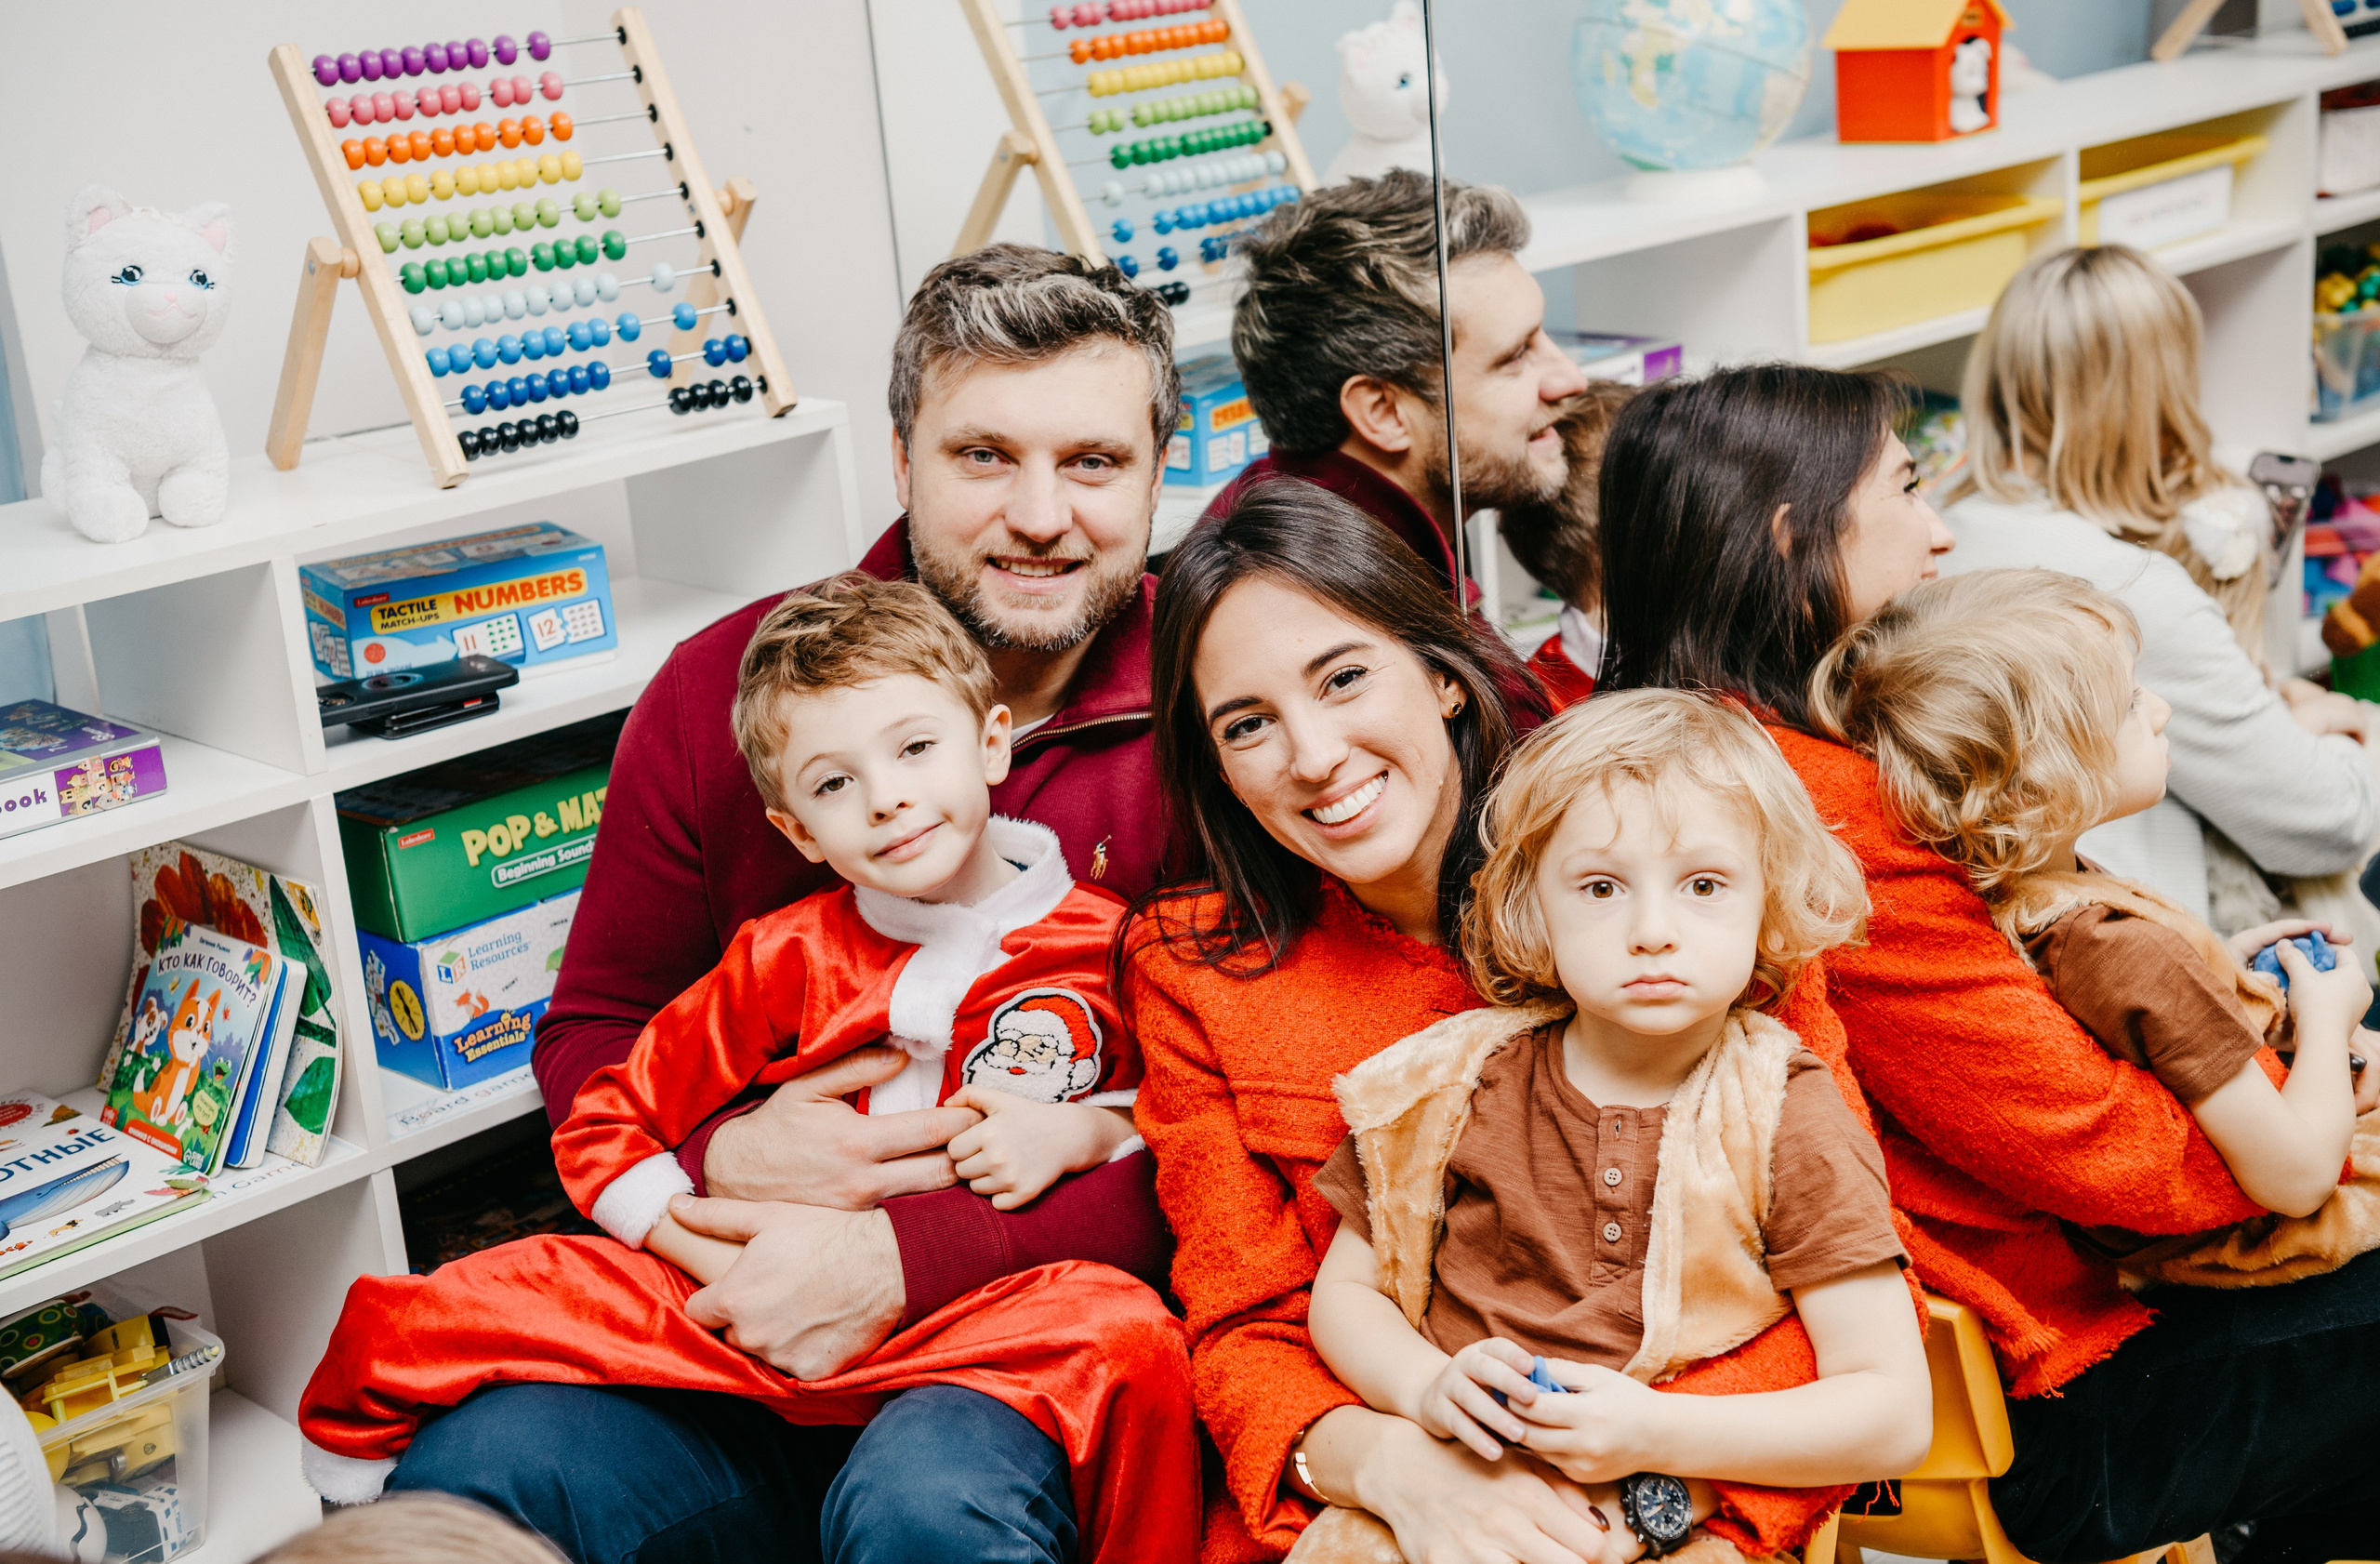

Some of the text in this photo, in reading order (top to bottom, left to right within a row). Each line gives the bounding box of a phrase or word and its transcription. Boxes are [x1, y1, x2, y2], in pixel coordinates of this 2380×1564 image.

[454, 572, 583, 614] NUMBERS
[378, 599, 437, 619] TACTILE
[380, 612, 440, 630] MATCH-UPS
[537, 618, 556, 638] 12
[464, 634, 477, 652] 11
[0, 789, 47, 815] ook
[461, 815, 531, 868] POP
[534, 811, 559, 839] &
[497, 840, 595, 882] Beginning Sound
[469, 932, 522, 958] Learning
[470, 942, 530, 971] Resources
[158, 952, 257, 1008] КТО КАК ГОВОРИТ?
[454, 1010, 531, 1054] Learning
[465, 1030, 526, 1063] Essentials
[400, 1095, 470, 1125] Board
